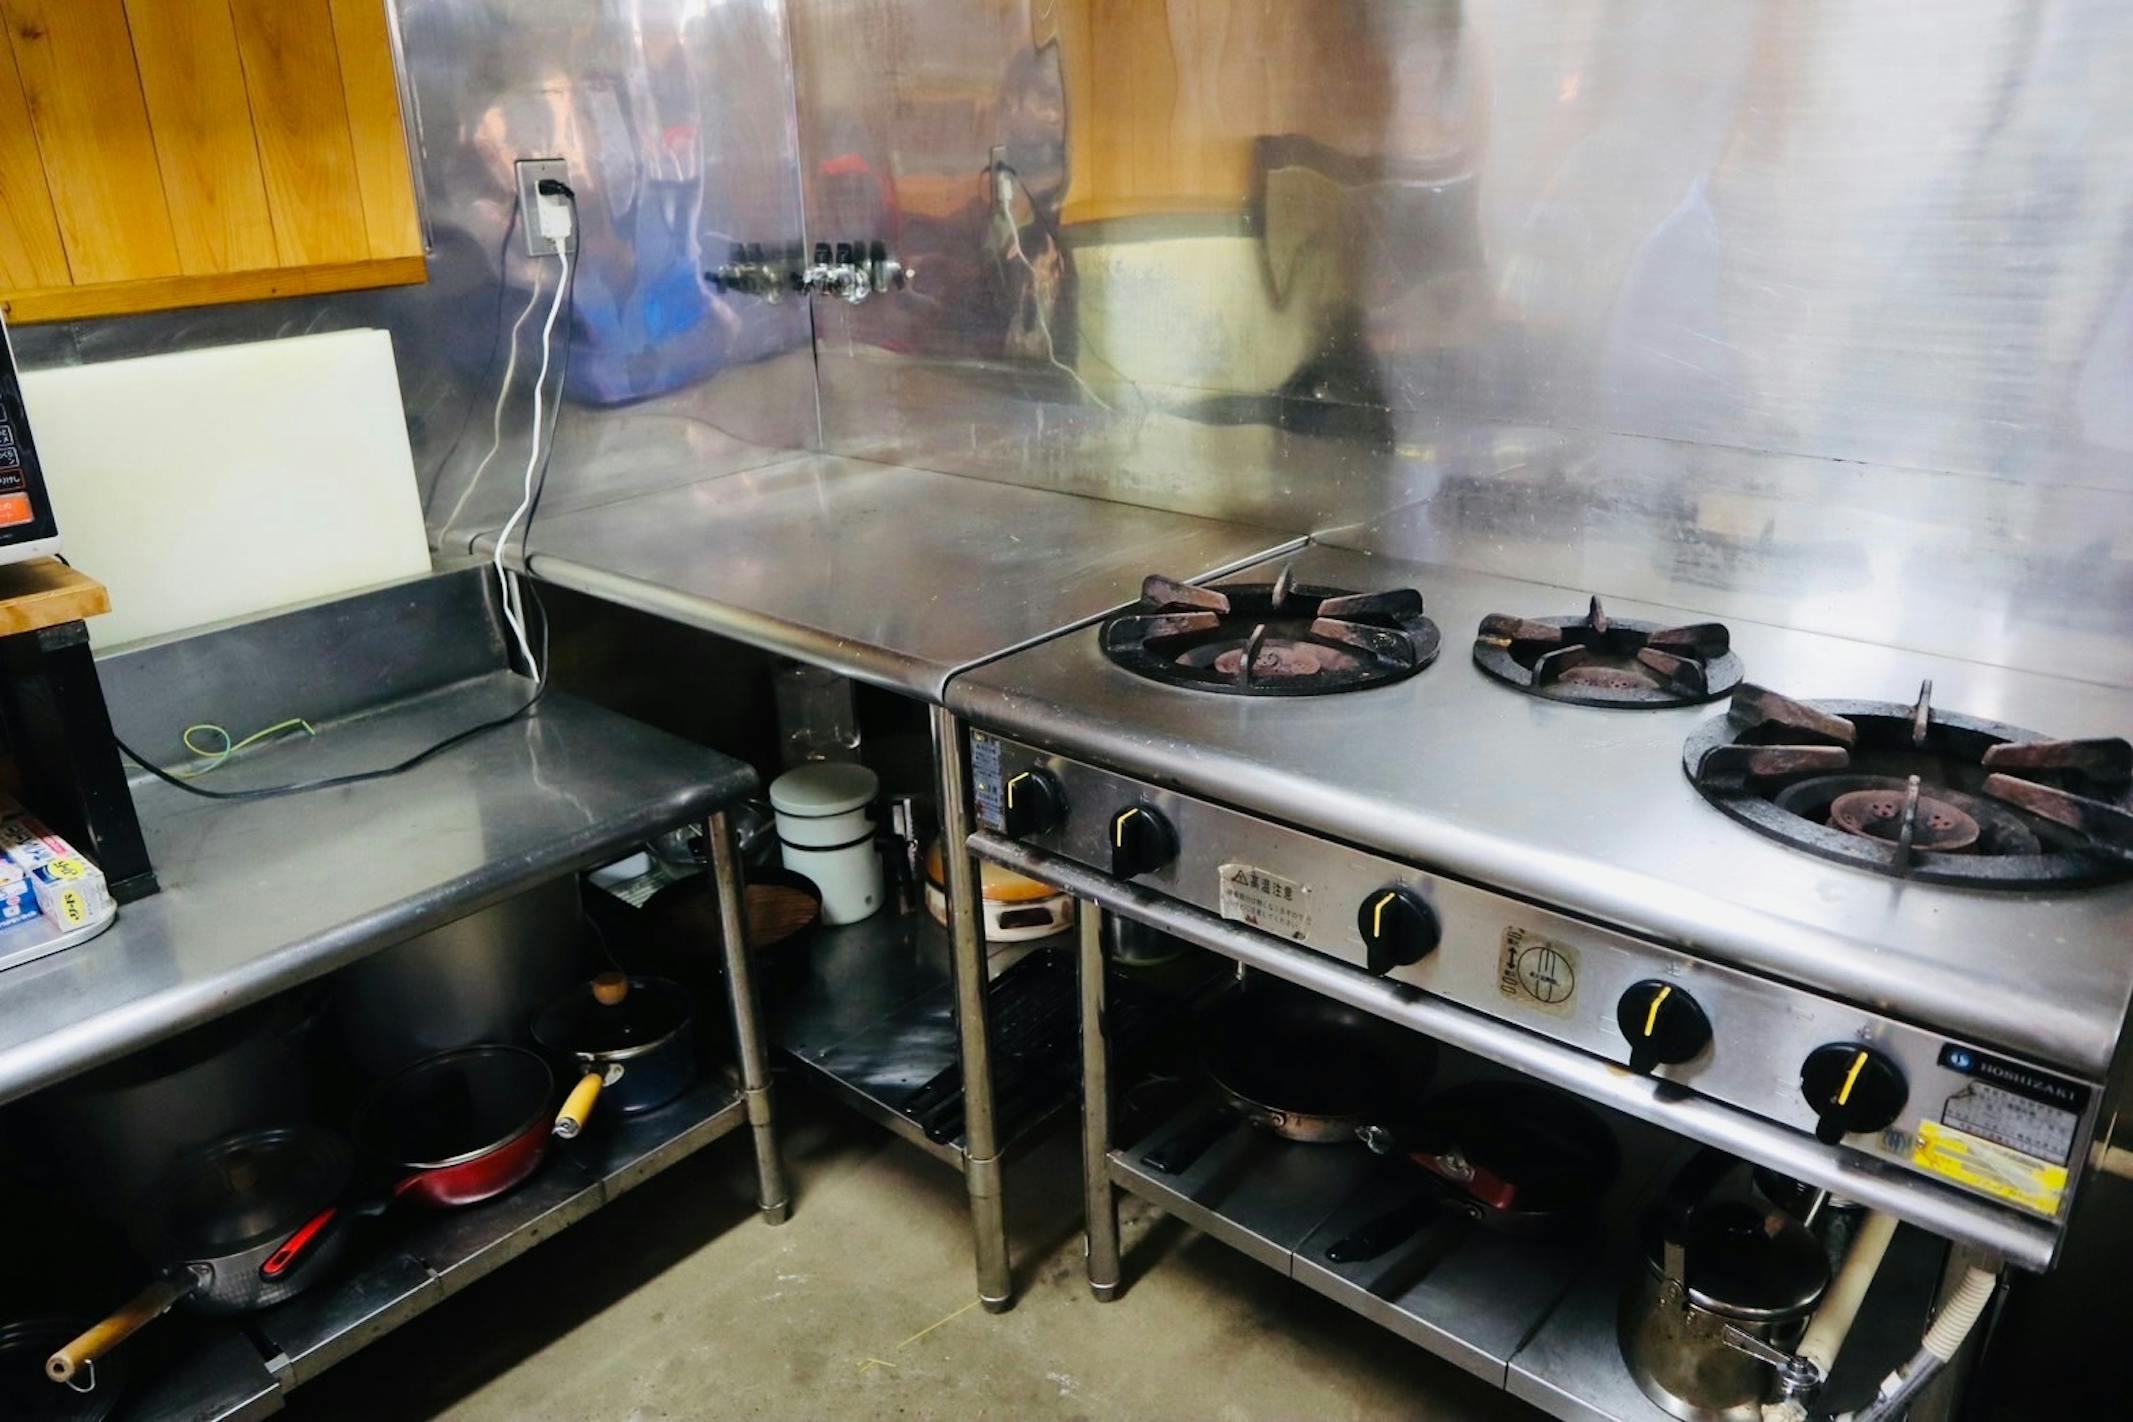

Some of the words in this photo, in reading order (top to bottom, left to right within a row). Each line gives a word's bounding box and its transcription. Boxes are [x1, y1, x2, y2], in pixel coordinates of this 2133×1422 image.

[0, 475, 20, 485] りけし
[1250, 869, 1294, 902] 高温注意
[1979, 1061, 2077, 1101] HOSHIZAKI
